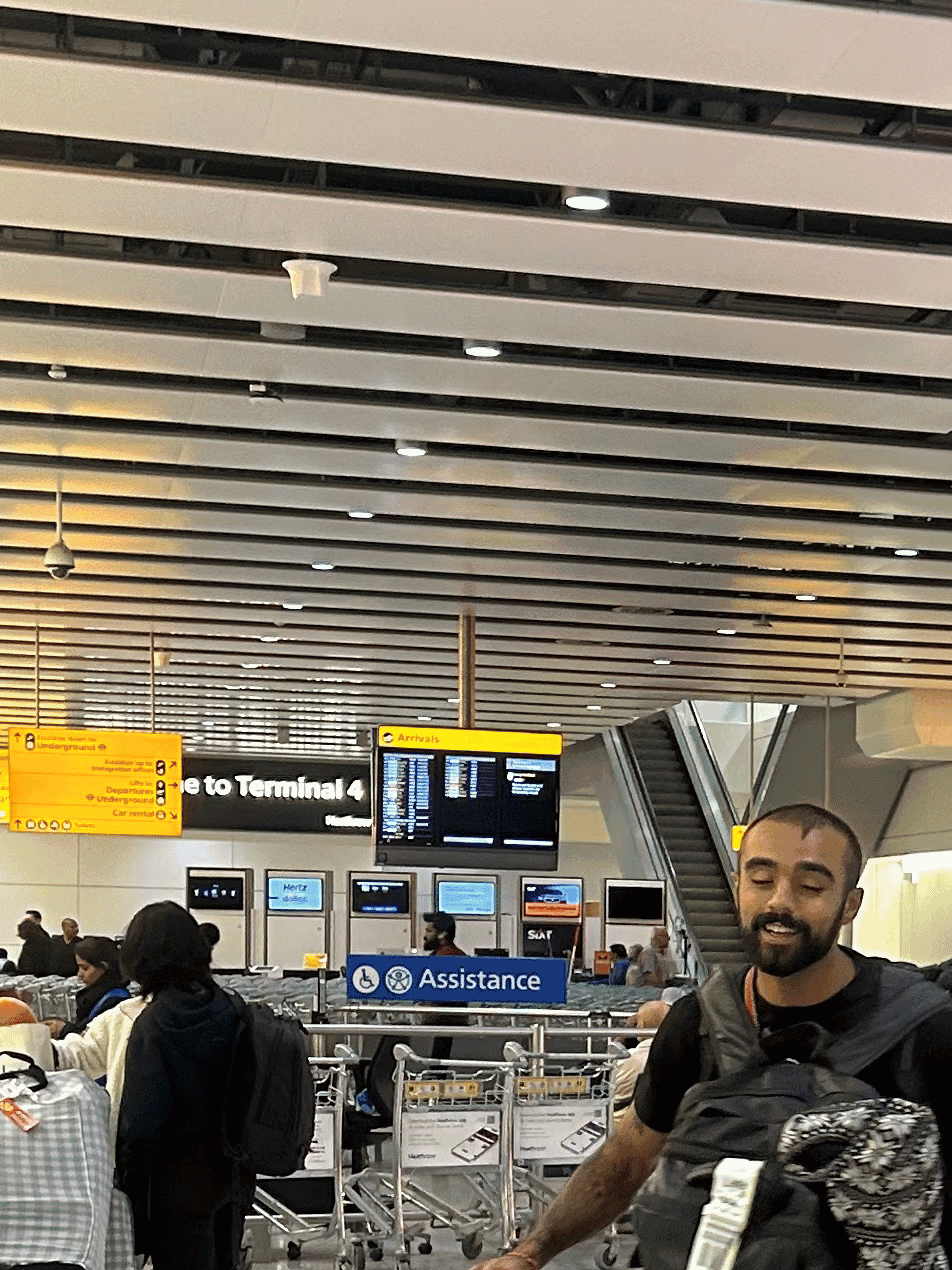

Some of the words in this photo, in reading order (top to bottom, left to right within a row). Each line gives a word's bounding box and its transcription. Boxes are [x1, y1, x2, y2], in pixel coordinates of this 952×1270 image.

[398, 733, 440, 743] Arrivals
[37, 743, 96, 752] Underground
[180, 777, 200, 796] e
[203, 775, 232, 796] to
[235, 775, 343, 800] Terminal
[346, 779, 364, 801] 4
[418, 966, 541, 991] Assistance
